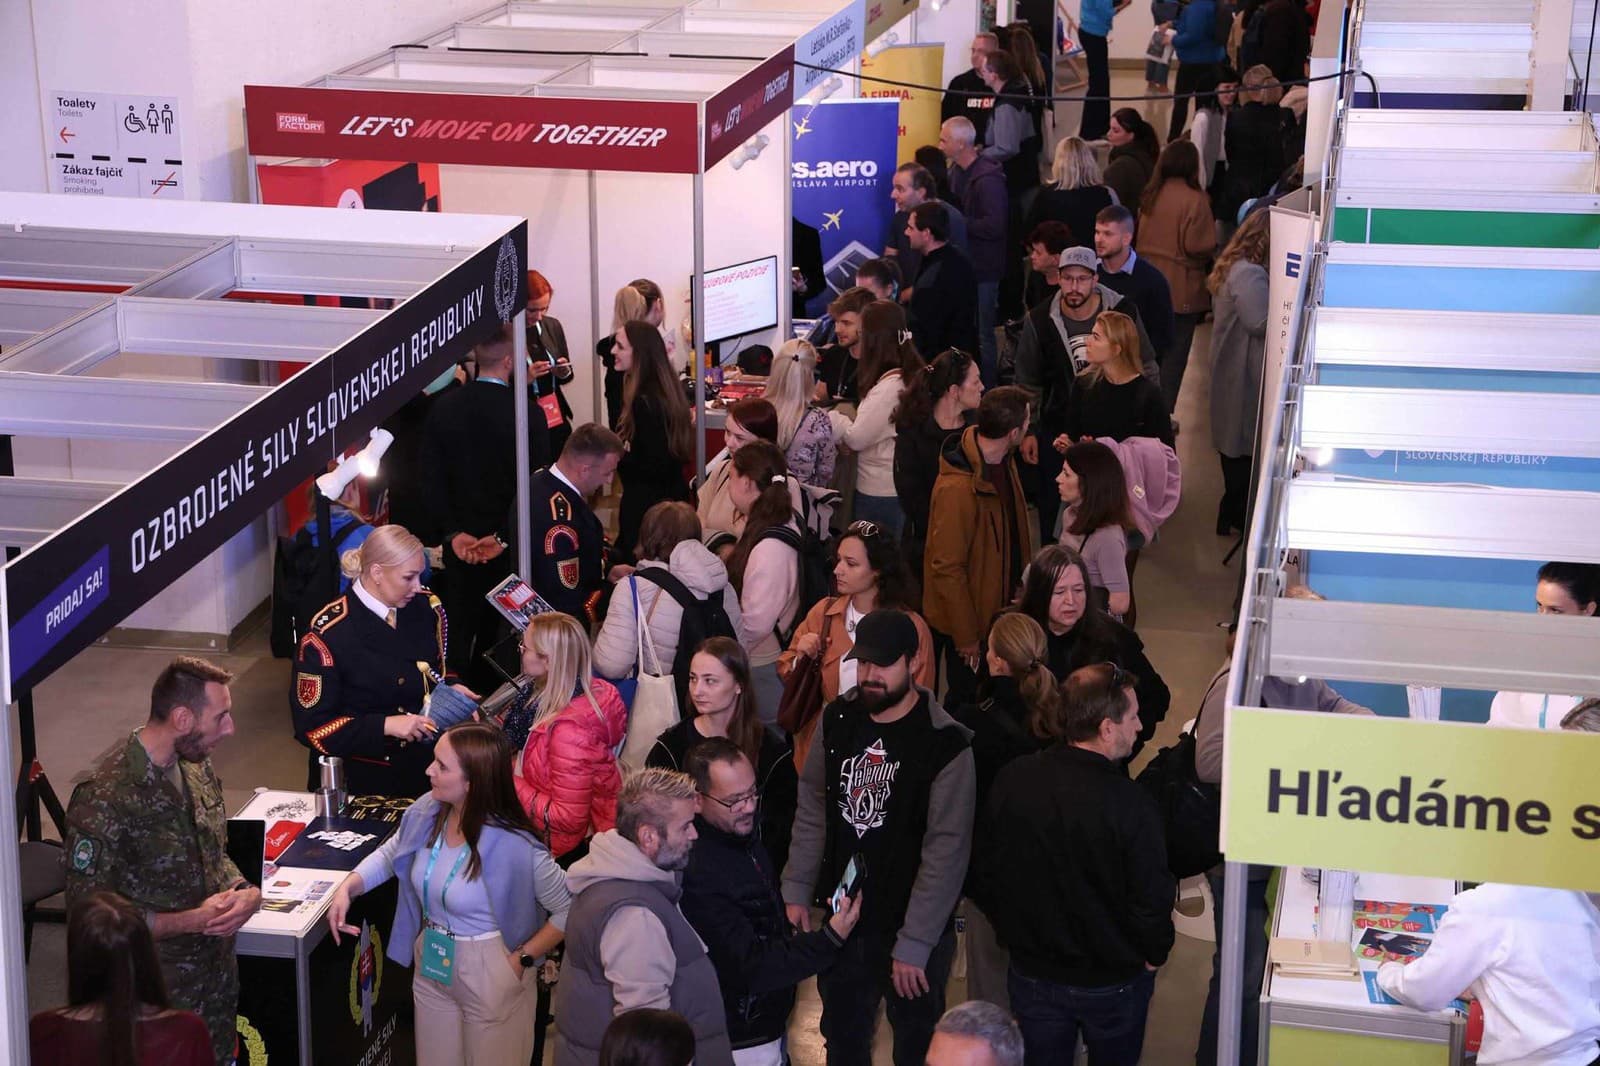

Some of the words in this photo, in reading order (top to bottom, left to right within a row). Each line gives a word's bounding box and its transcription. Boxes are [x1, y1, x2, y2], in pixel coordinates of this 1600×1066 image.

[57, 97, 96, 110] Toalety
[58, 108, 83, 118] Toilets
[279, 115, 306, 123] FORM
[279, 121, 323, 131] FACTORY
[340, 115, 414, 138] LET'S
[411, 119, 492, 140] MOVE
[491, 122, 535, 142] ON
[532, 123, 668, 147] TOGETHER
[62, 164, 93, 176] Zákaz
[96, 165, 123, 178] fajčiť
[791, 160, 878, 179] s.aero
[63, 176, 97, 186] Smoking
[834, 179, 878, 187] AIRPORT
[64, 186, 104, 195] prohibited
[131, 440, 255, 573] OZBROJENÉ
[262, 417, 299, 478] SILY
[306, 342, 406, 445] SLOVENSKEJ
[411, 284, 484, 368] REPUBLIKY
[1405, 450, 1478, 464] SLOVENSKEJ
[1482, 453, 1548, 465] REPUBLIKY
[46, 584, 83, 634] PRIDAJ
[85, 566, 103, 599] SA!
[1267, 767, 1551, 836] Hľadáme
[1571, 804, 1600, 840] s
